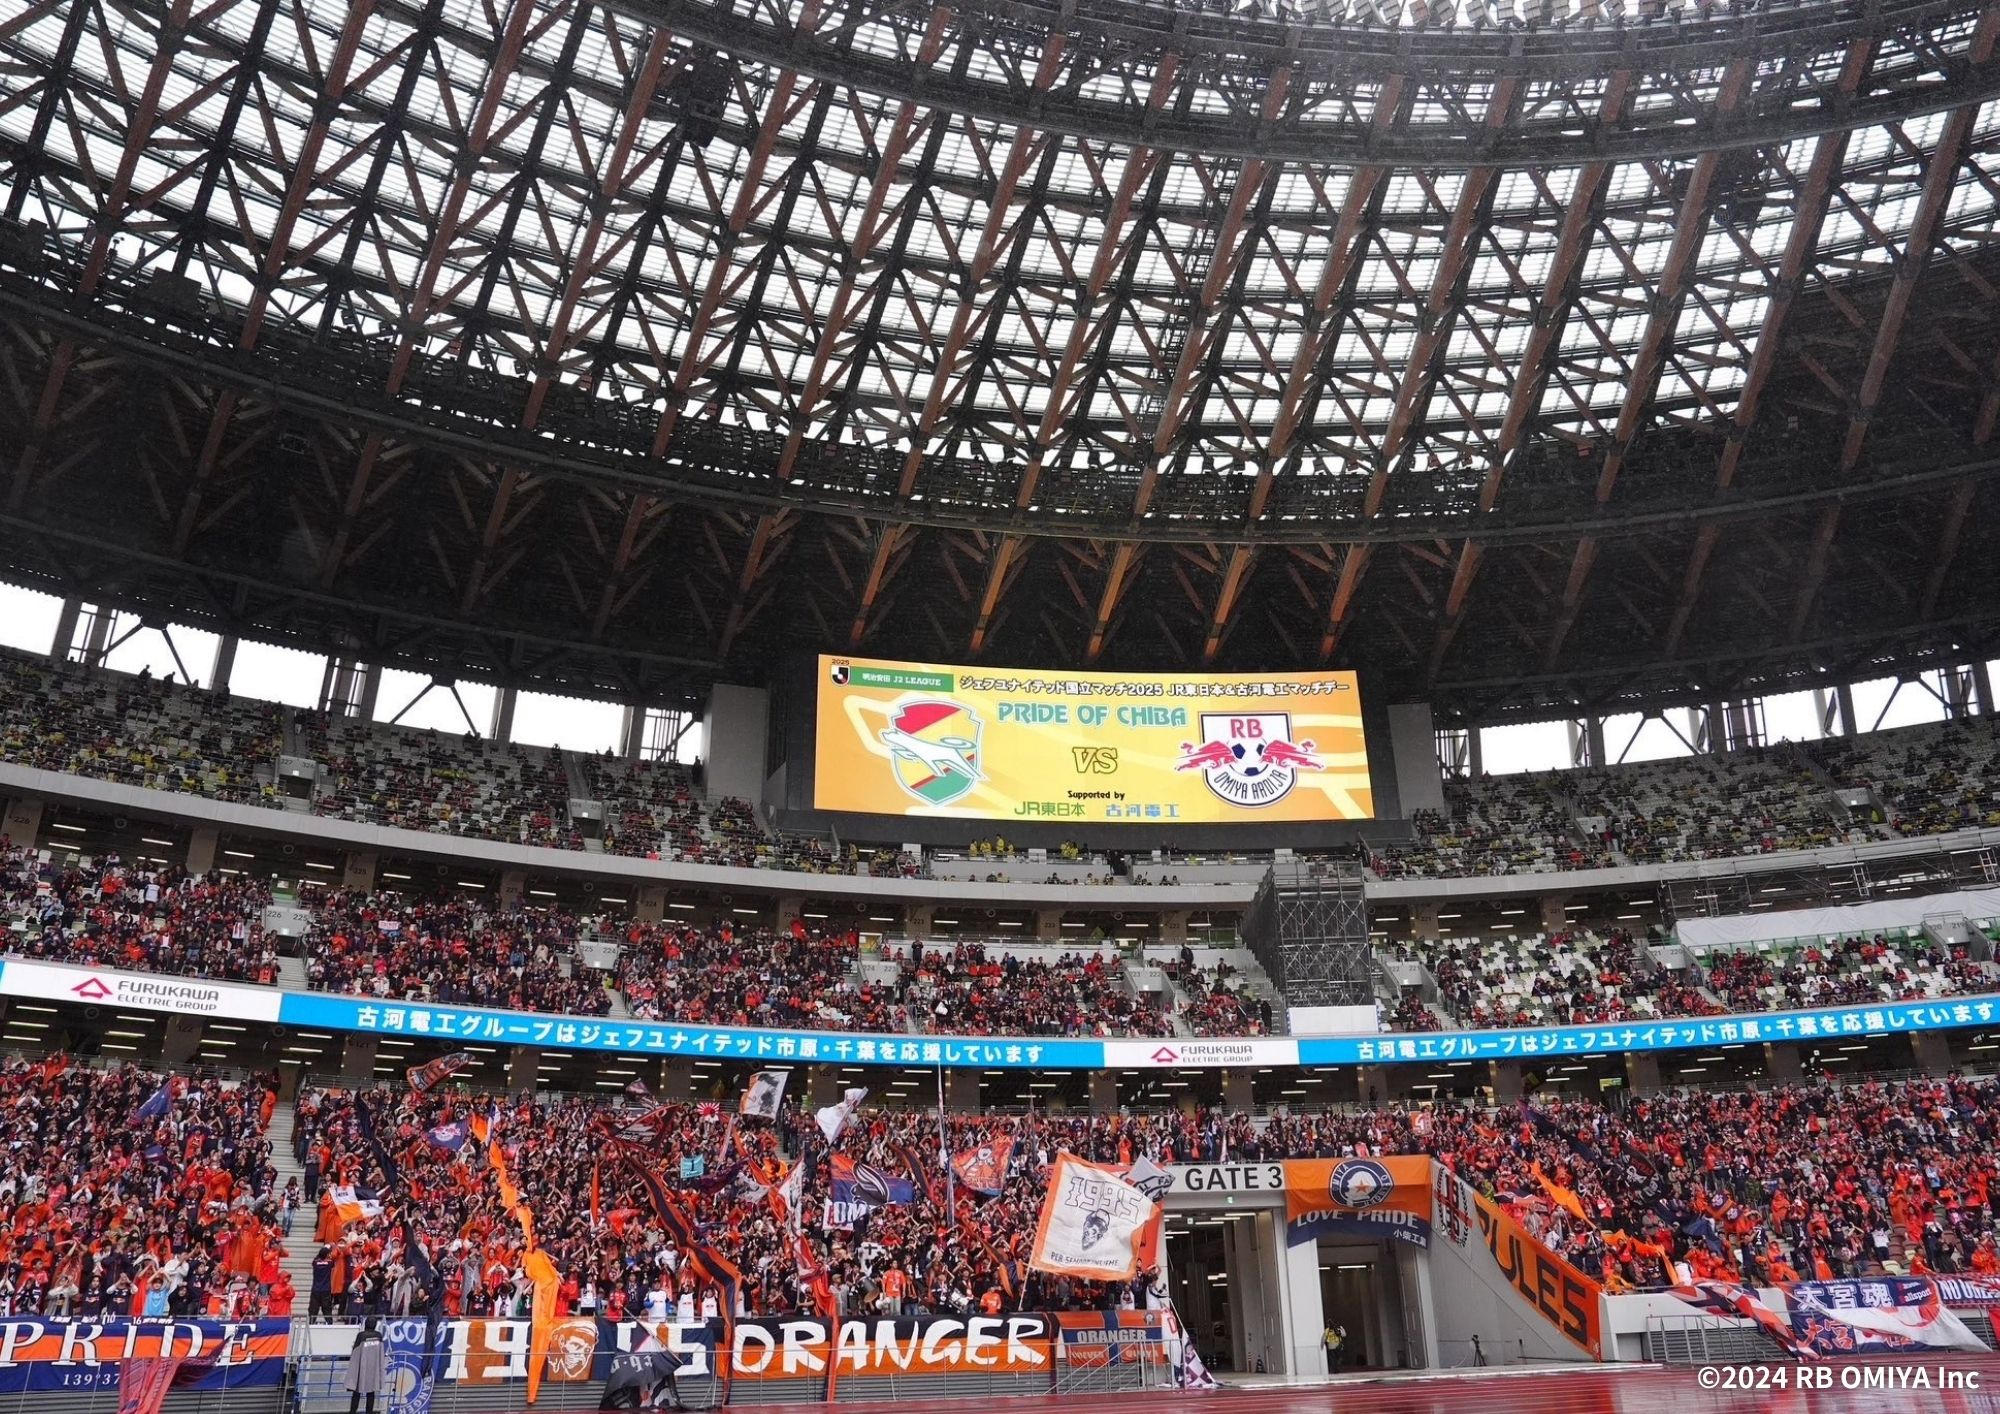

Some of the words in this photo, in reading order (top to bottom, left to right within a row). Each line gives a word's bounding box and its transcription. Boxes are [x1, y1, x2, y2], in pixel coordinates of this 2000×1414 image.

[905, 677, 941, 686] LEAGUE
[999, 702, 1068, 724] PRIDE
[1077, 705, 1109, 726] OF
[1117, 705, 1187, 726] CHIBA
[1230, 719, 1263, 738] RB
[1072, 747, 1118, 774] VS
[1214, 771, 1248, 799] OMIYA
[1251, 770, 1288, 799] ARDIJA
[1068, 791, 1110, 800] Supported
[1114, 791, 1125, 800] by
[1014, 802, 1085, 816] JR東日本
[1106, 804, 1180, 818] 古河電工
[118, 980, 219, 1001] FURUKAWA
[117, 994, 171, 1007] ELECTRIC
[175, 1001, 217, 1011] GROUP
[357, 1006, 1043, 1062] 古河電工グループはジェフユナイテッド市原・千葉を応援しています
[1358, 1002, 1994, 1059] 古河電工グループはジェフユナイテッド市原・千葉を応援しています
[1181, 1045, 1253, 1054] FURUKAWA
[1223, 1055, 1253, 1063] GROUP
[1184, 1167, 1261, 1190] GATE
[1268, 1166, 1283, 1189] 3
[1065, 1176, 1144, 1225] 1995
[1297, 1209, 1344, 1228] LOVE
[1357, 1209, 1419, 1229] PRIDE
[1797, 1283, 1893, 1311] 大宮魂
[1904, 1287, 1932, 1303] allsport
[0, 1322, 257, 1367] PRIDE
[732, 1317, 1046, 1375] ORANGER
[1076, 1329, 1147, 1344] ORANGER
[443, 1320, 532, 1379] 19
